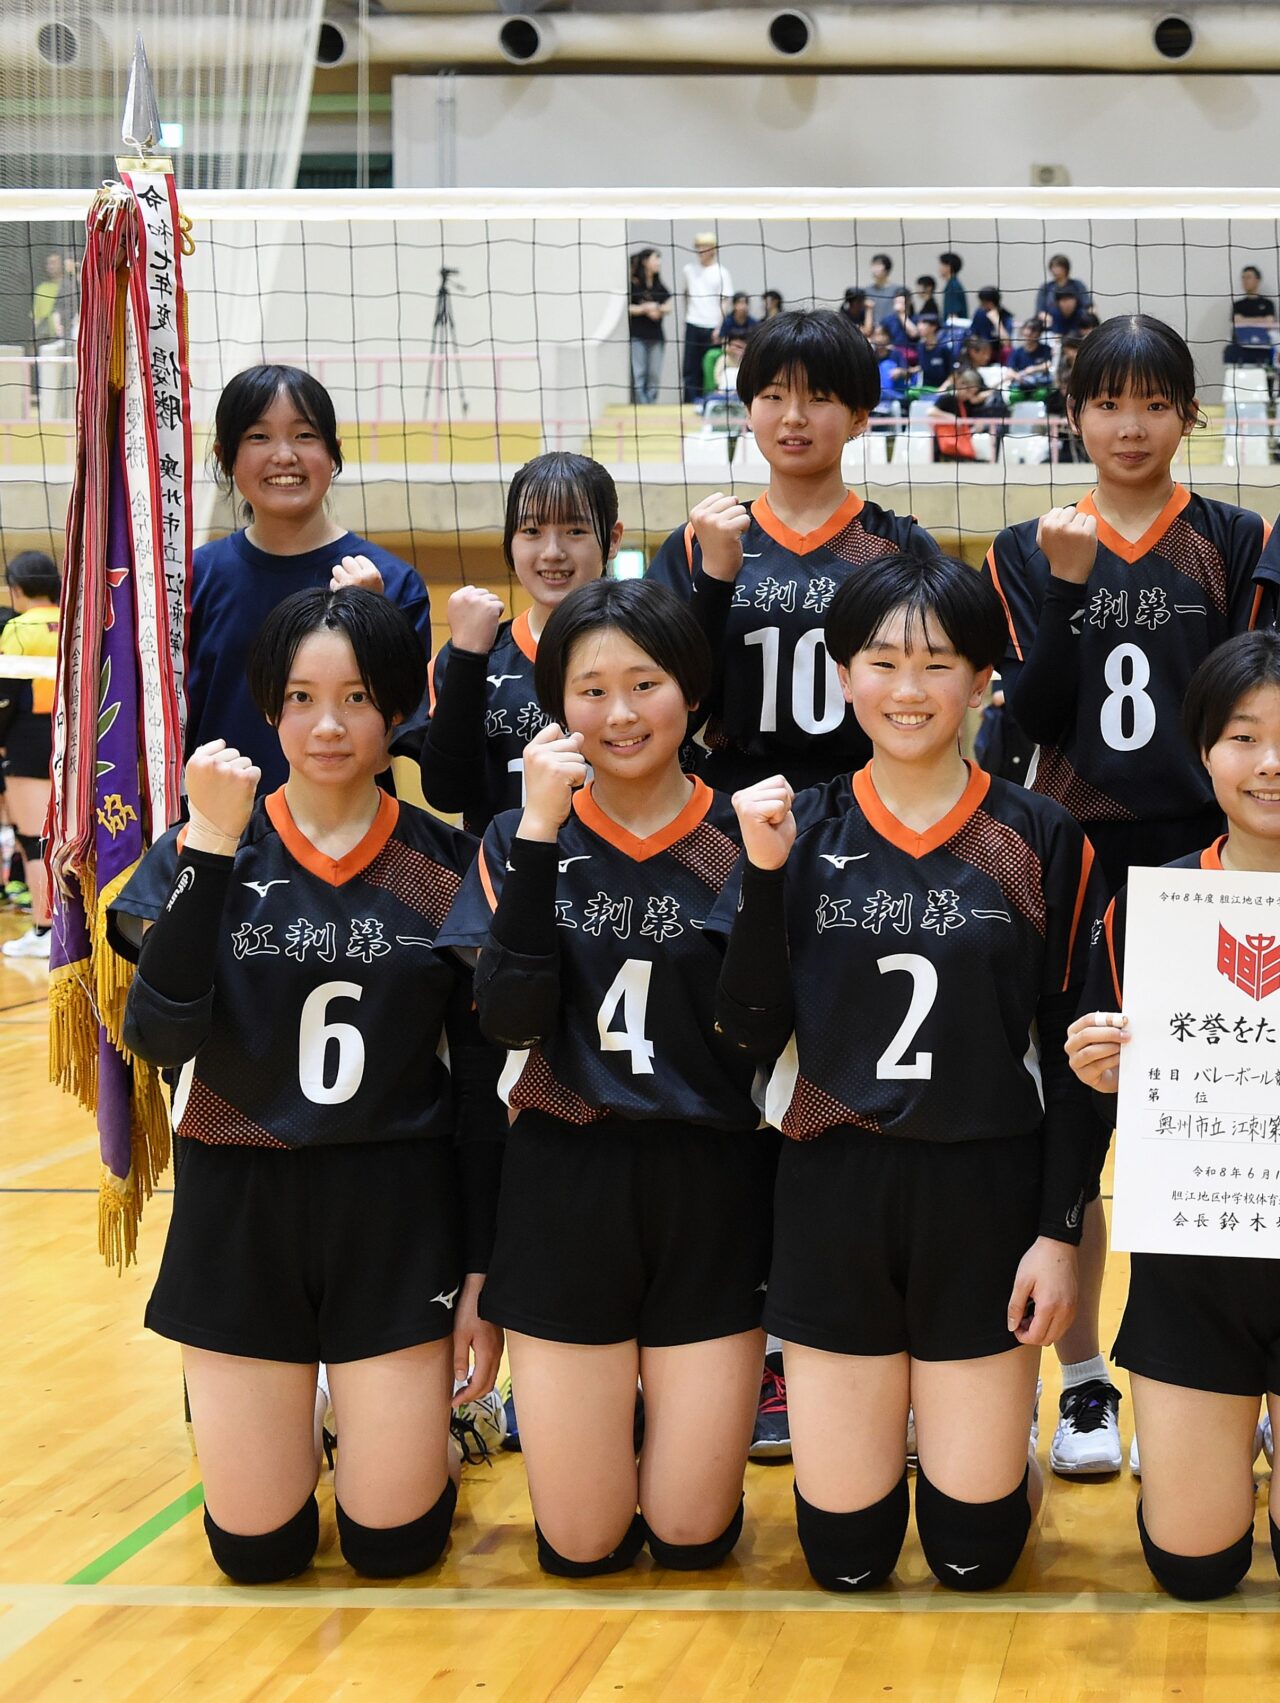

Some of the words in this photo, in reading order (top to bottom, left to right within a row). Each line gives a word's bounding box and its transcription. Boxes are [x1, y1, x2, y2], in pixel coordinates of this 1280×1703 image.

[743, 626, 846, 735] 10
[1100, 642, 1156, 752] 8
[231, 918, 435, 963] 江刺第一
[816, 889, 1012, 936] 江刺第一
[1159, 891, 1214, 905] 令和8年度
[298, 980, 365, 1105] 6
[597, 958, 655, 1075] 4
[876, 953, 938, 1080] 2
[1148, 1067, 1180, 1082] 種目
